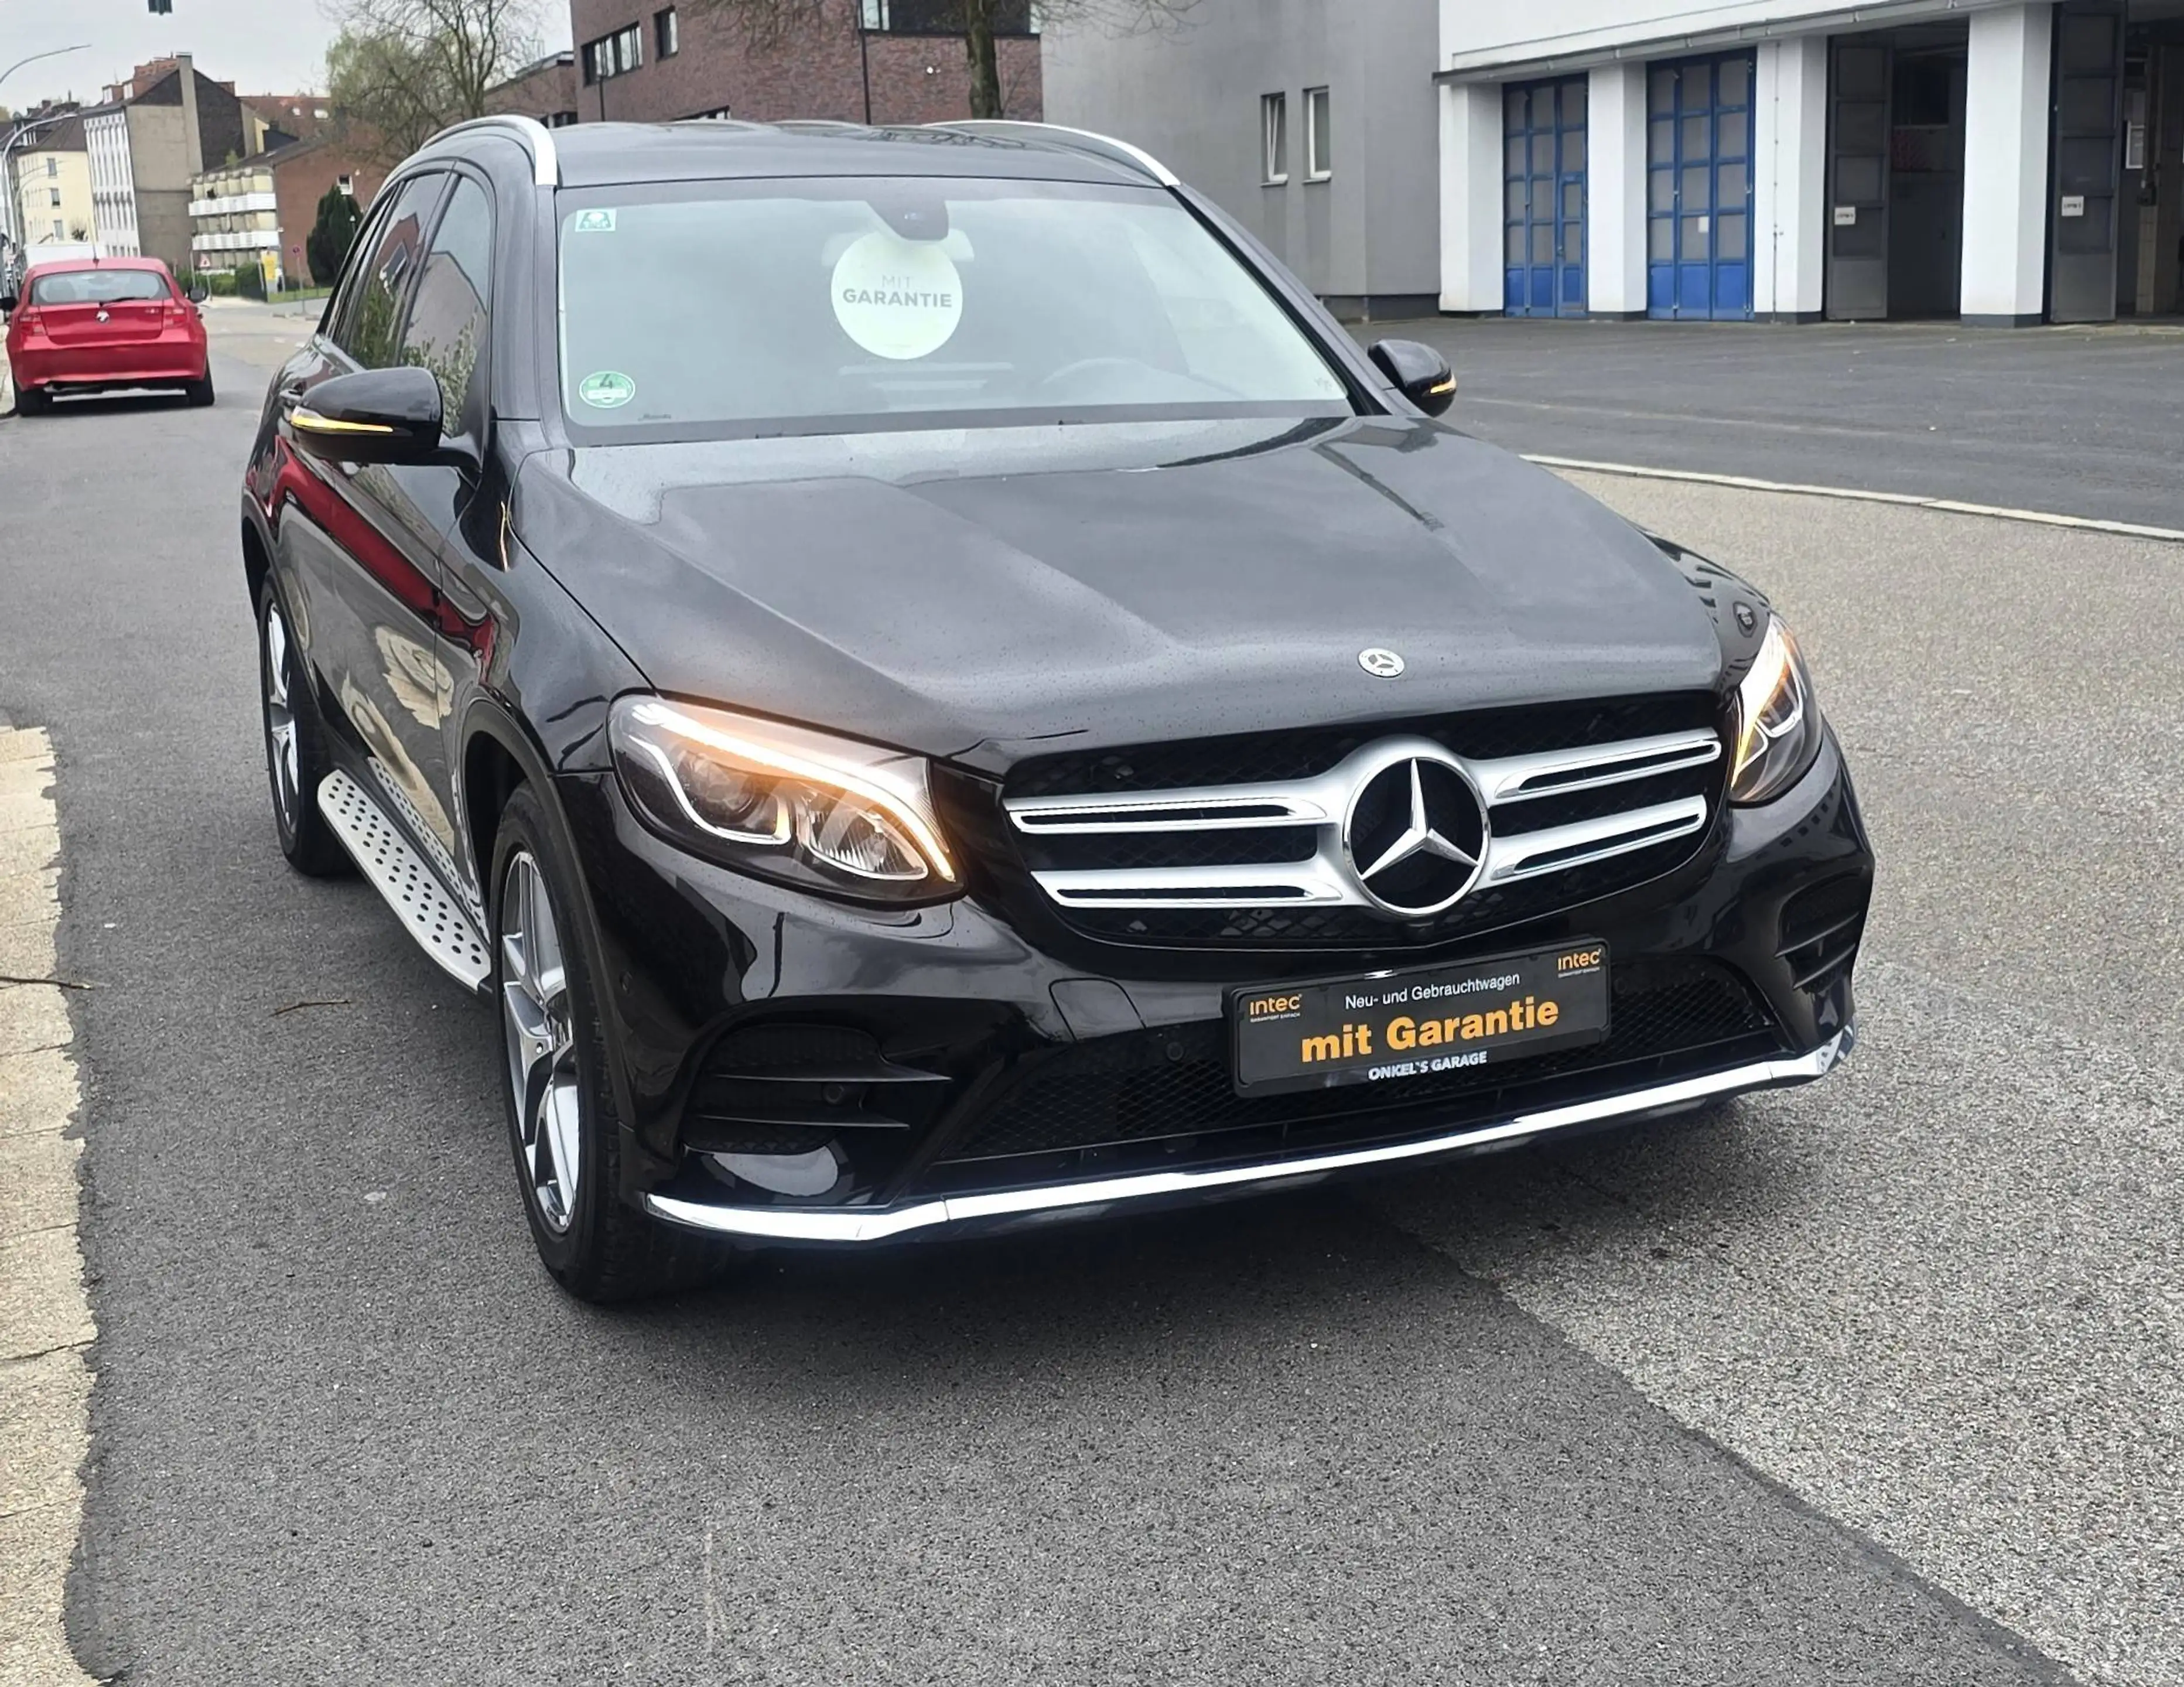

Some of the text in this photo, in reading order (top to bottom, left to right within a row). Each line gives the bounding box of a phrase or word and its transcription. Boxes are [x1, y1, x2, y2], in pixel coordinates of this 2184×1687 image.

[881, 275, 911, 288] MIT
[843, 288, 952, 308] GARANTIE
[599, 373, 613, 389] 4
[1345, 974, 1520, 1009] Neu- und Gebrauchtwagen
[1301, 996, 1559, 1063] mit Garantie
[1430, 1051, 1488, 1072] GARAGE
